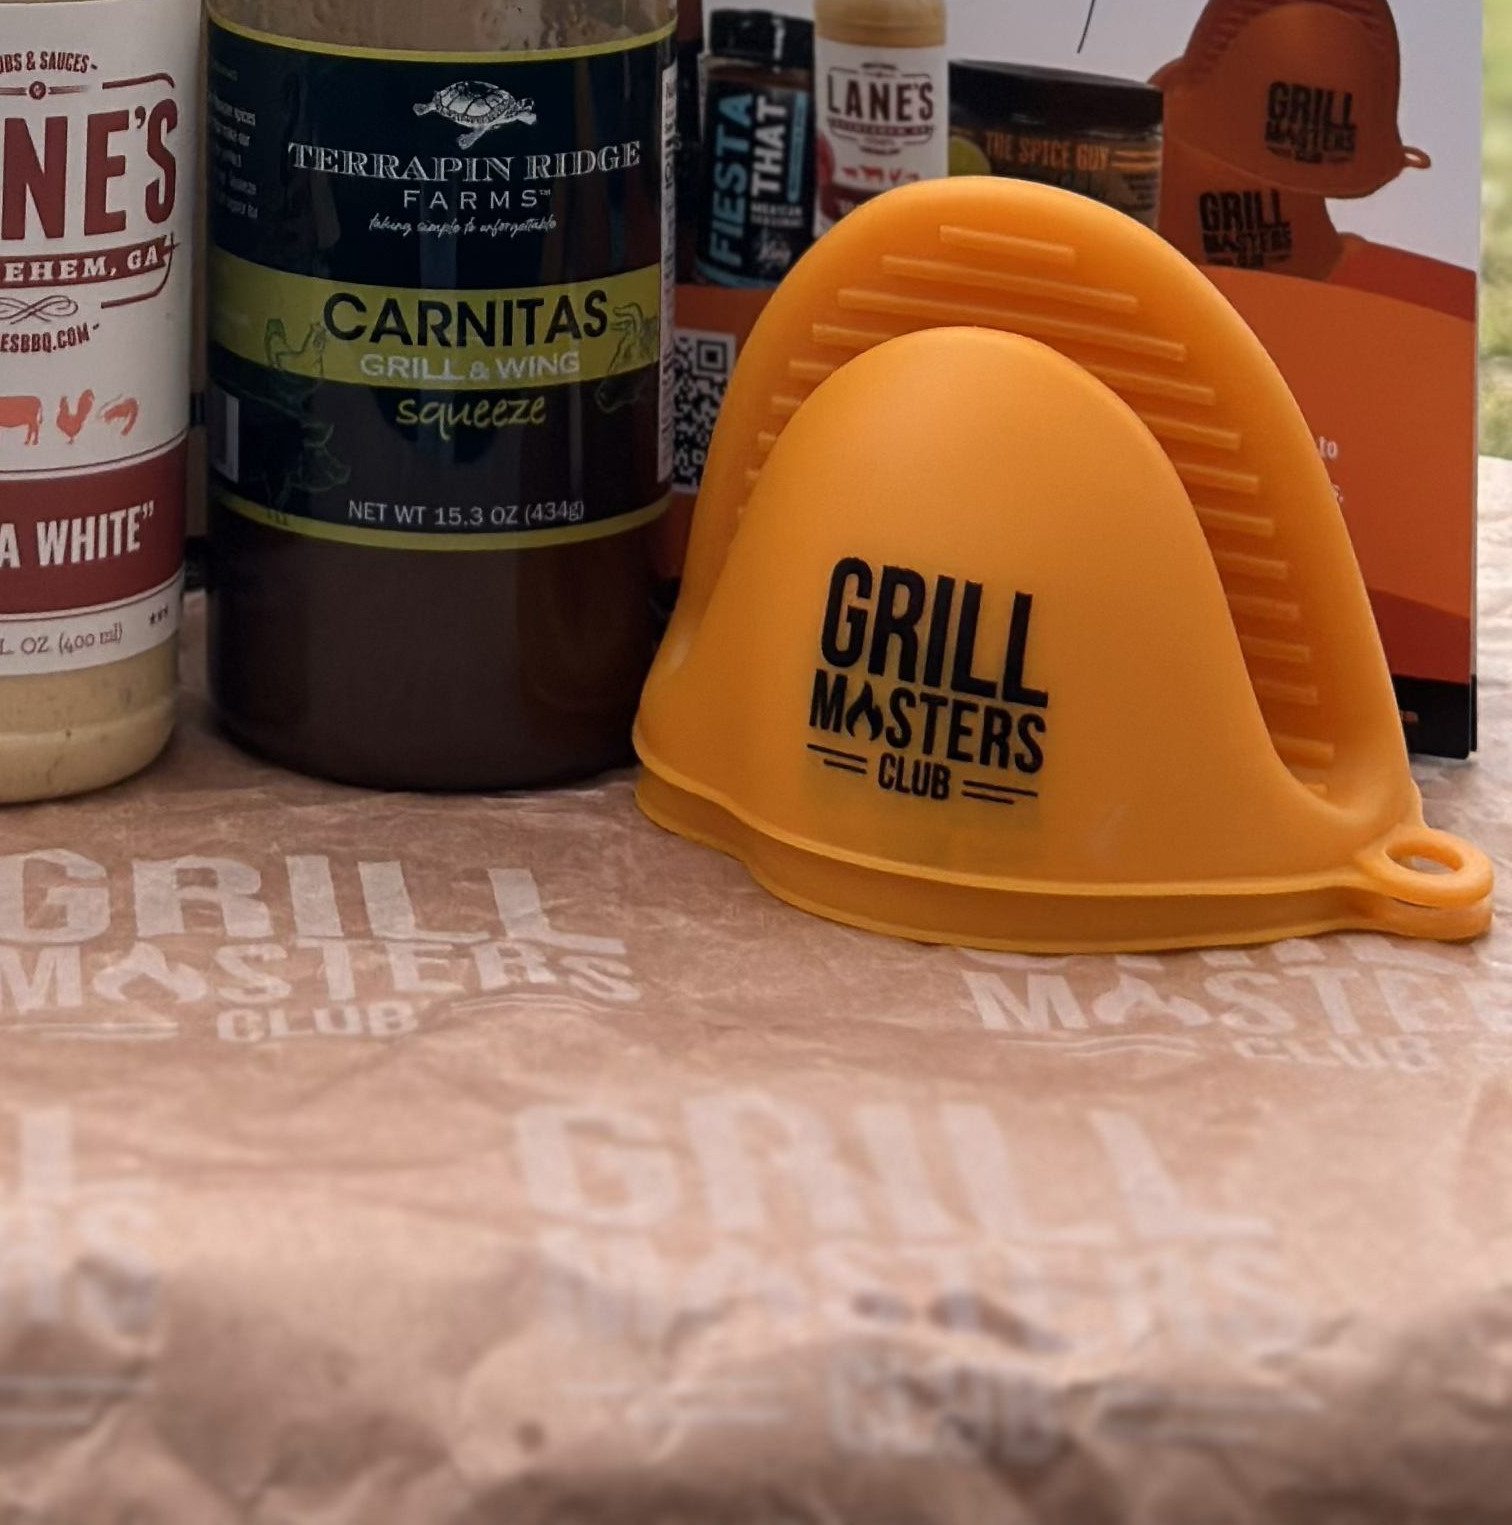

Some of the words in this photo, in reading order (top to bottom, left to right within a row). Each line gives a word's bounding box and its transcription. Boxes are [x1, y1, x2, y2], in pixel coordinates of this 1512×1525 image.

[828, 78, 934, 122] LANE'S
[1267, 80, 1357, 130] GRILL
[288, 141, 514, 183] TERRAPIN
[525, 140, 642, 180] RIDGE
[750, 95, 787, 197] THAT
[984, 131, 1014, 161] THE
[1019, 135, 1070, 170] SPICE
[1075, 144, 1110, 171] GUY
[709, 93, 753, 267] FIESTA
[1199, 187, 1292, 232] GRILL
[126, 247, 159, 270] GA
[322, 288, 609, 349] CARNITAS
[360, 352, 464, 382] GRILL
[469, 361, 489, 380] &
[495, 350, 580, 379] WING
[395, 394, 547, 442] squeeze
[1317, 435, 1339, 460] to
[349, 500, 388, 522] NET
[394, 505, 427, 525] WT
[434, 506, 484, 526] 15.3
[490, 505, 519, 525] OZ
[524, 500, 585, 526] (434g)
[20, 636, 51, 655] OZ
[59, 632, 95, 655] (400
[821, 556, 1049, 709] GRILL
[808, 668, 1047, 775] MASTERS
[877, 752, 952, 801] CLUB
[215, 999, 420, 1044] CLUB
[512, 1089, 1278, 1246] GRILL
